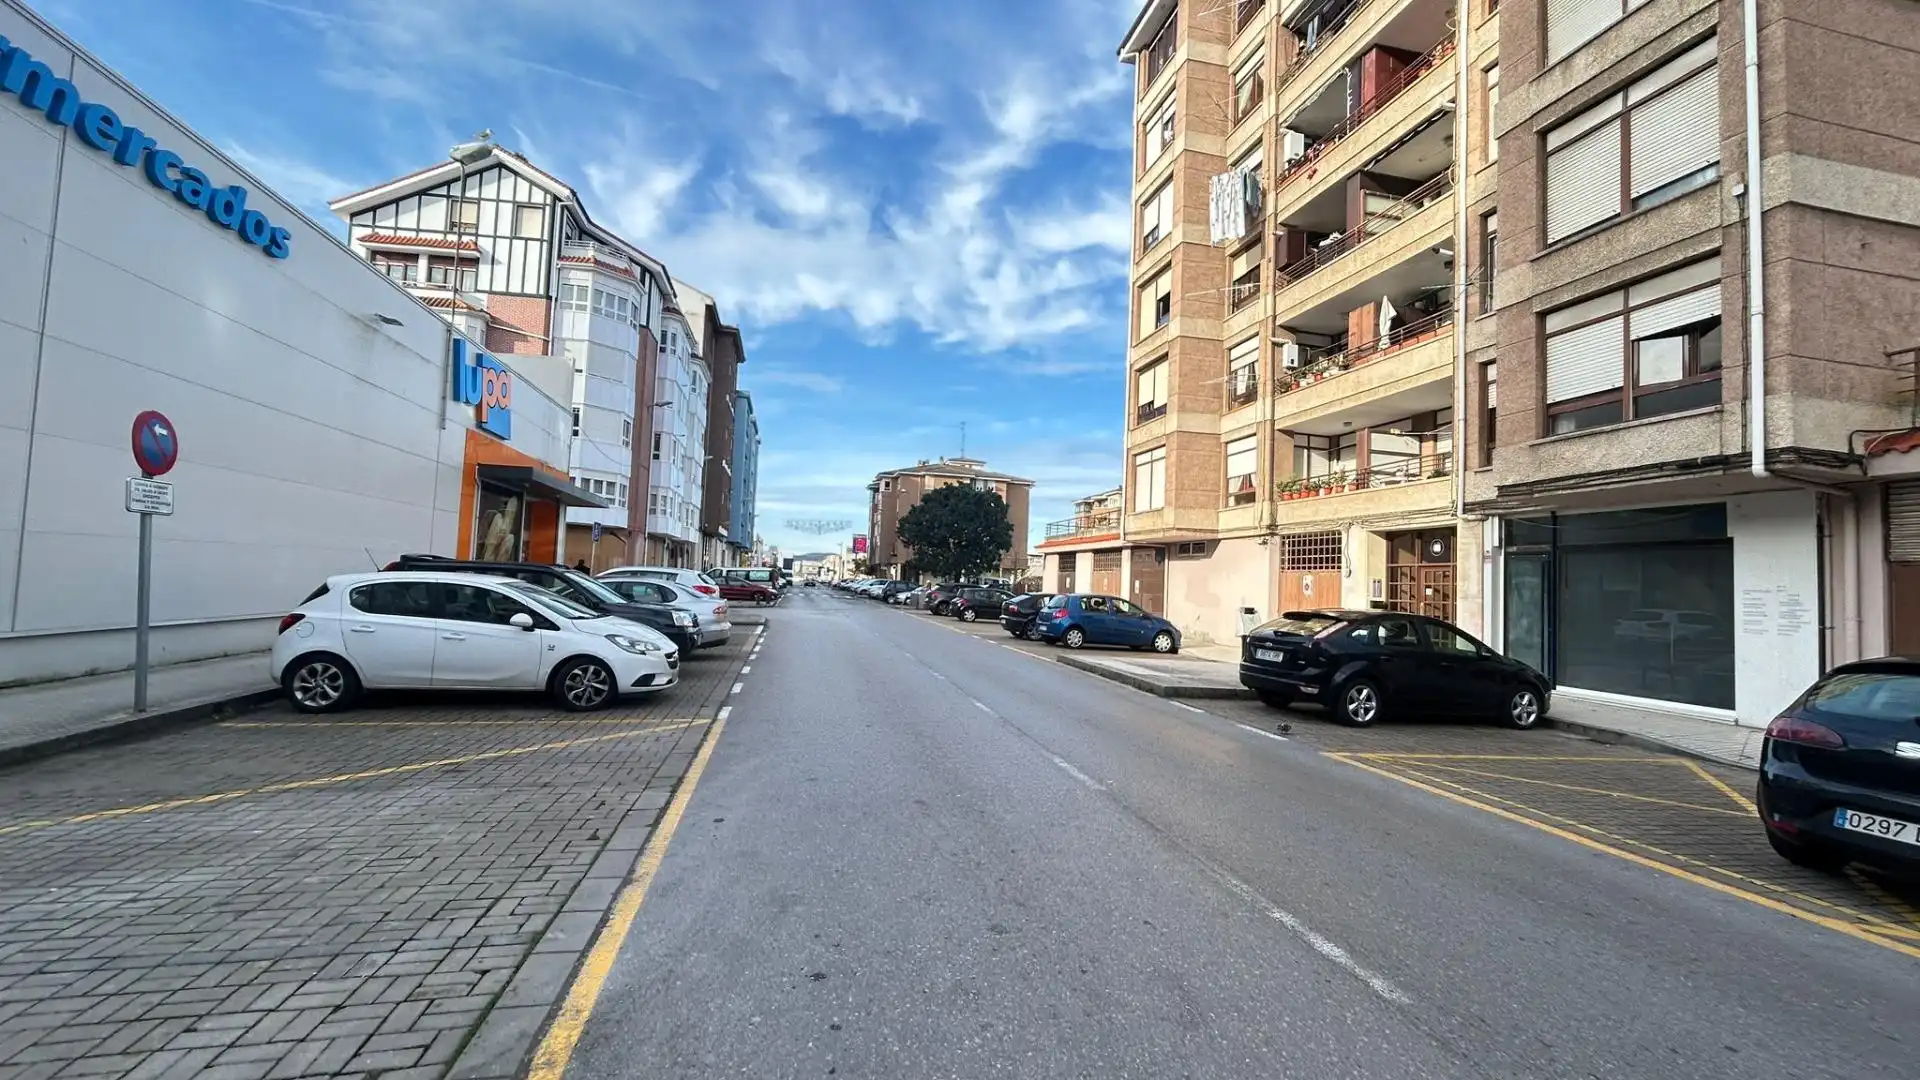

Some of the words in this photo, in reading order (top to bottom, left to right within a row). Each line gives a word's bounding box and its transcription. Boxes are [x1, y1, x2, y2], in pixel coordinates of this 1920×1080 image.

[0, 34, 292, 260] mercados
[453, 338, 511, 424] lupa
[1849, 813, 1908, 837] 0297
